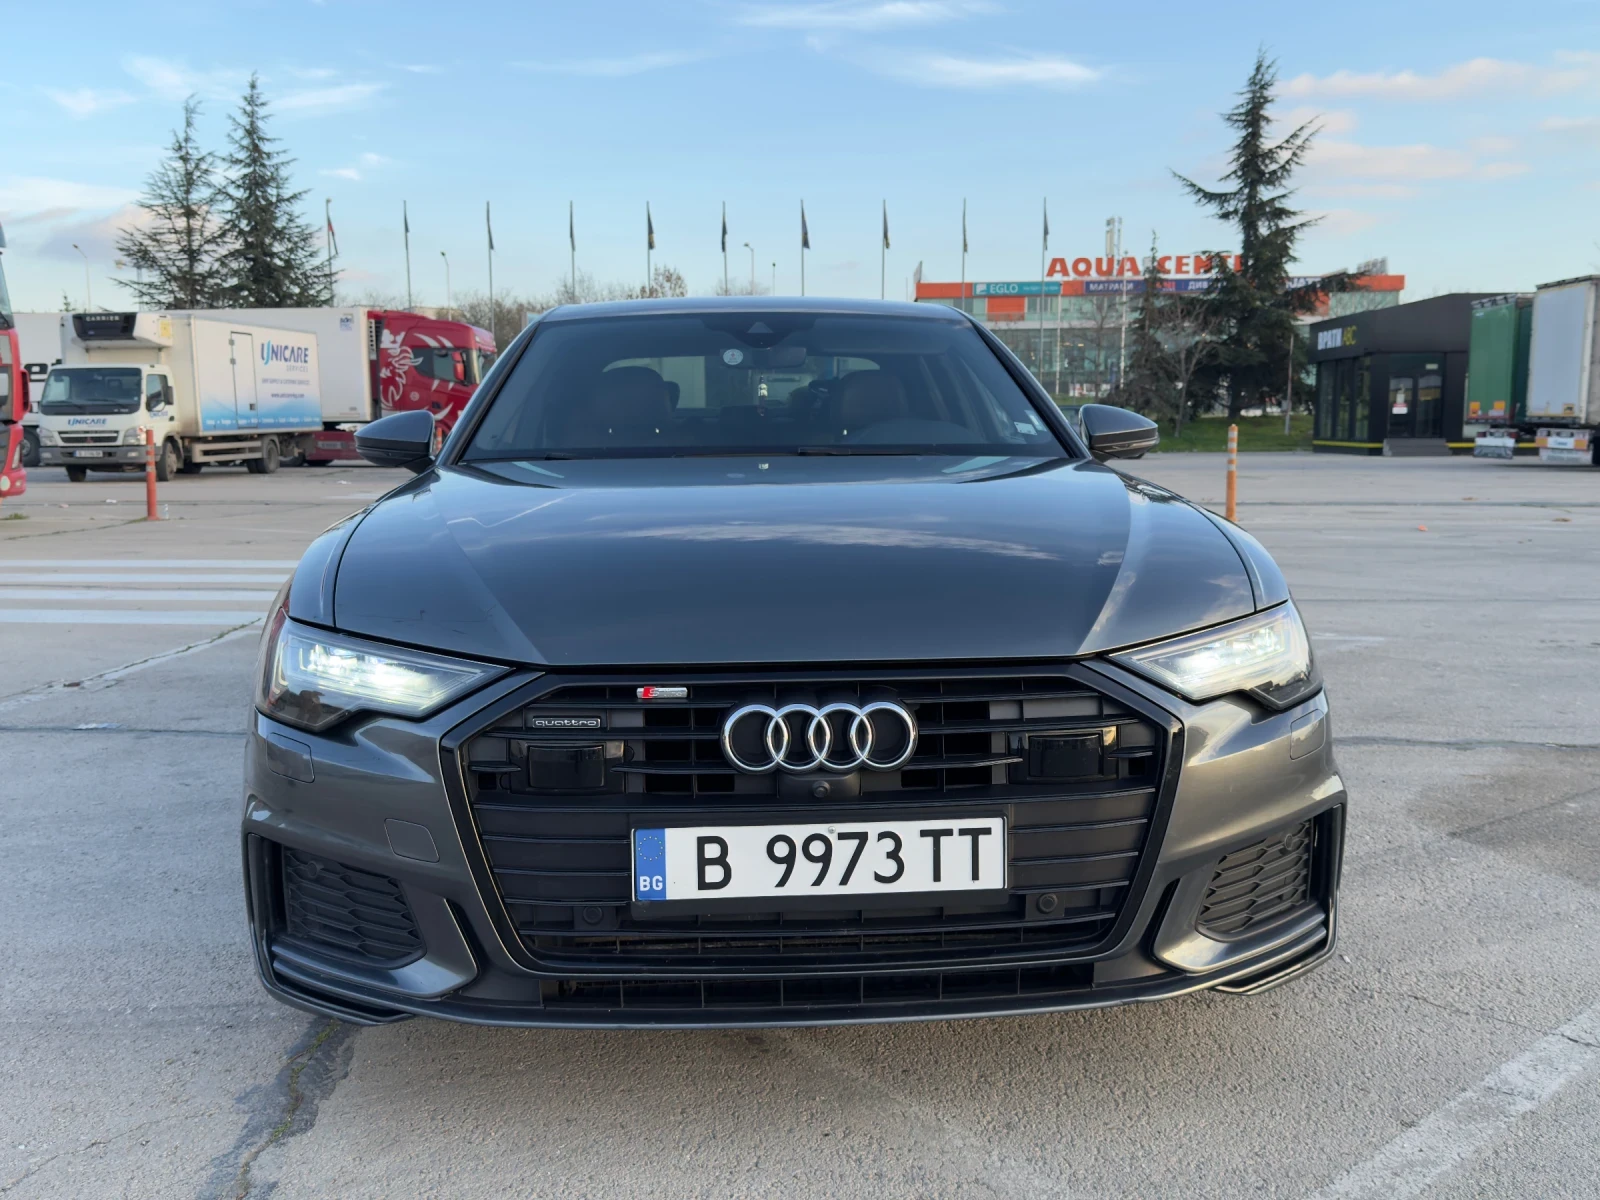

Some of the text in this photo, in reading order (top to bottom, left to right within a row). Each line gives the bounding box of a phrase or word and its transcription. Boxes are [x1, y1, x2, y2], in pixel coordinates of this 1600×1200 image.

[1046, 256, 1141, 277] AQUA
[989, 284, 1018, 293] EGLO
[260, 340, 309, 366] UNICARE
[67, 417, 107, 426] UNICARE
[535, 719, 597, 727] quattro
[696, 827, 992, 891] B 9973 TT
[639, 875, 664, 892] BG
